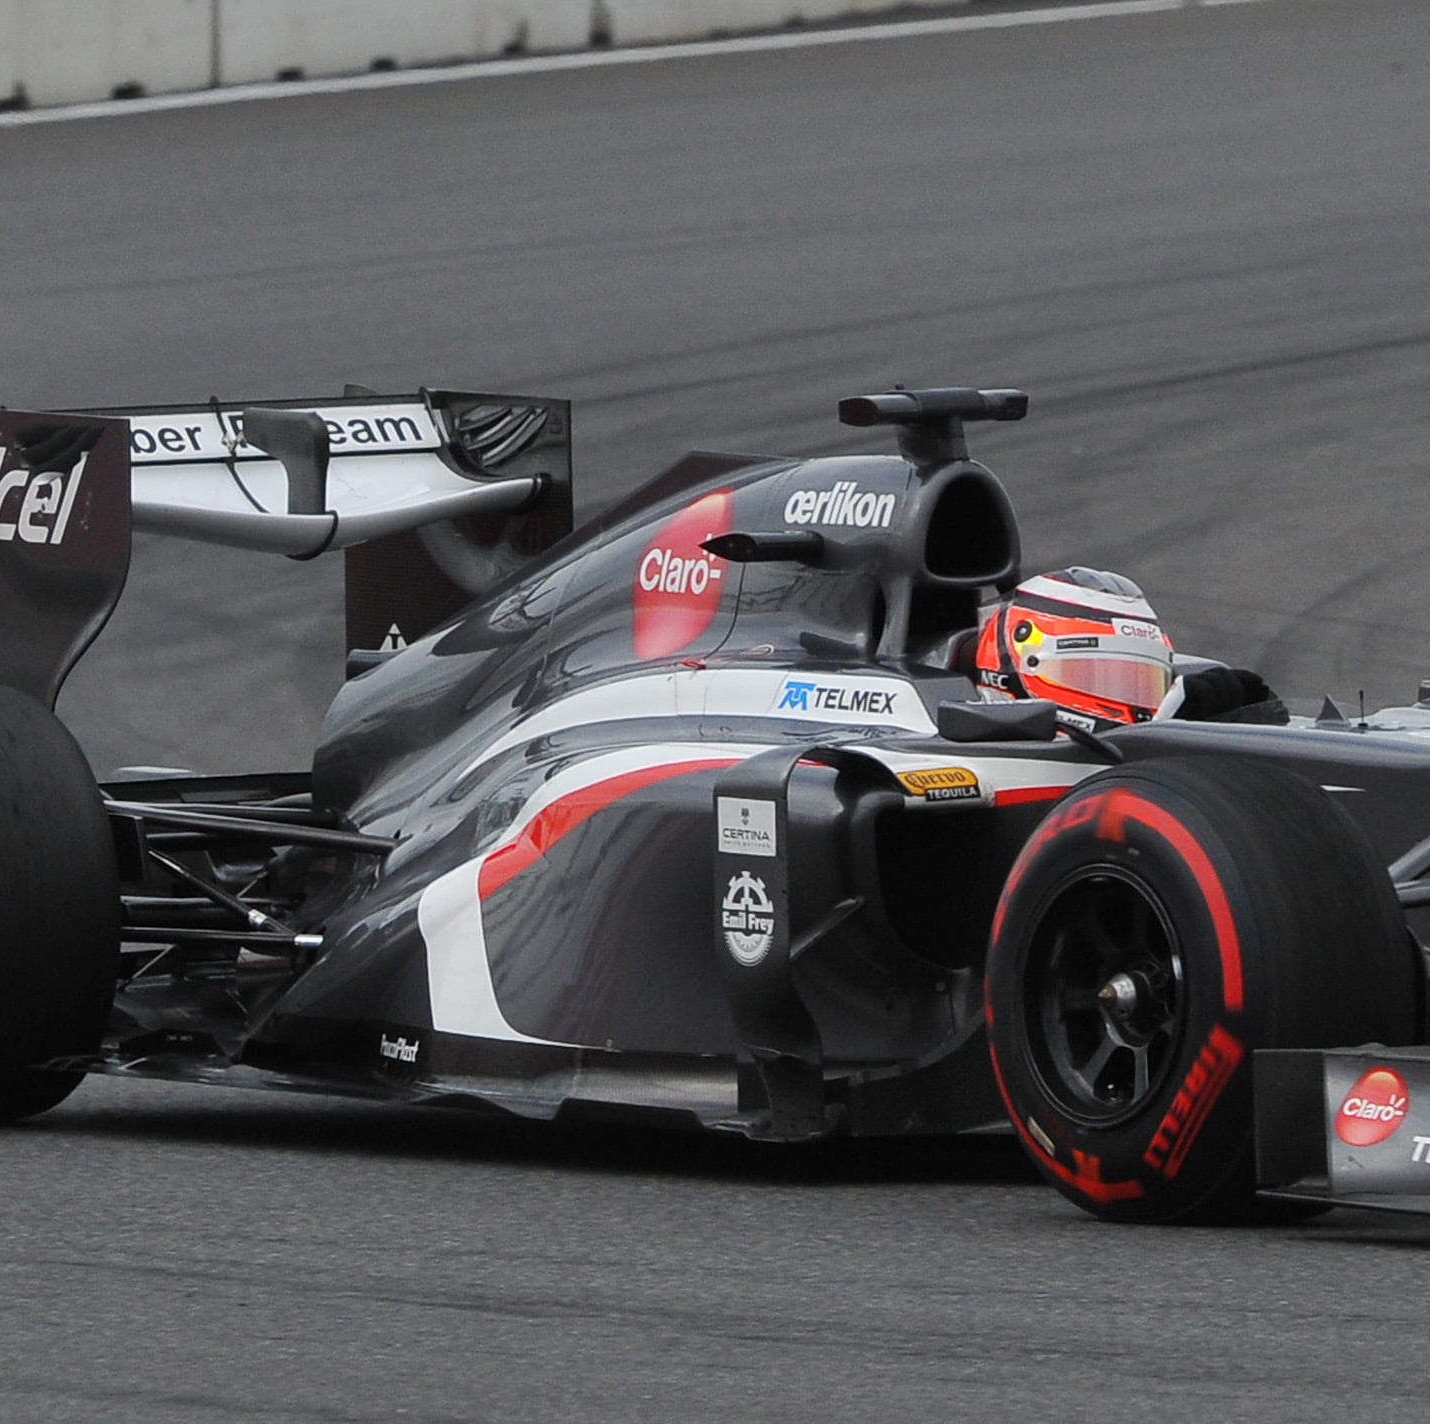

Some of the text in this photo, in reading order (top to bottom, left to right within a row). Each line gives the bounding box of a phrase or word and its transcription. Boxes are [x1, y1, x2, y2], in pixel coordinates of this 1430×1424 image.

[328, 415, 423, 447] eam
[639, 548, 709, 595] Claro
[981, 669, 1009, 690] NEC
[815, 687, 898, 715] TELMEX
[928, 785, 979, 800] TEQUILA
[722, 827, 771, 842] CERTINA
[747, 912, 775, 935] Frey
[1343, 1097, 1395, 1122] Claro
